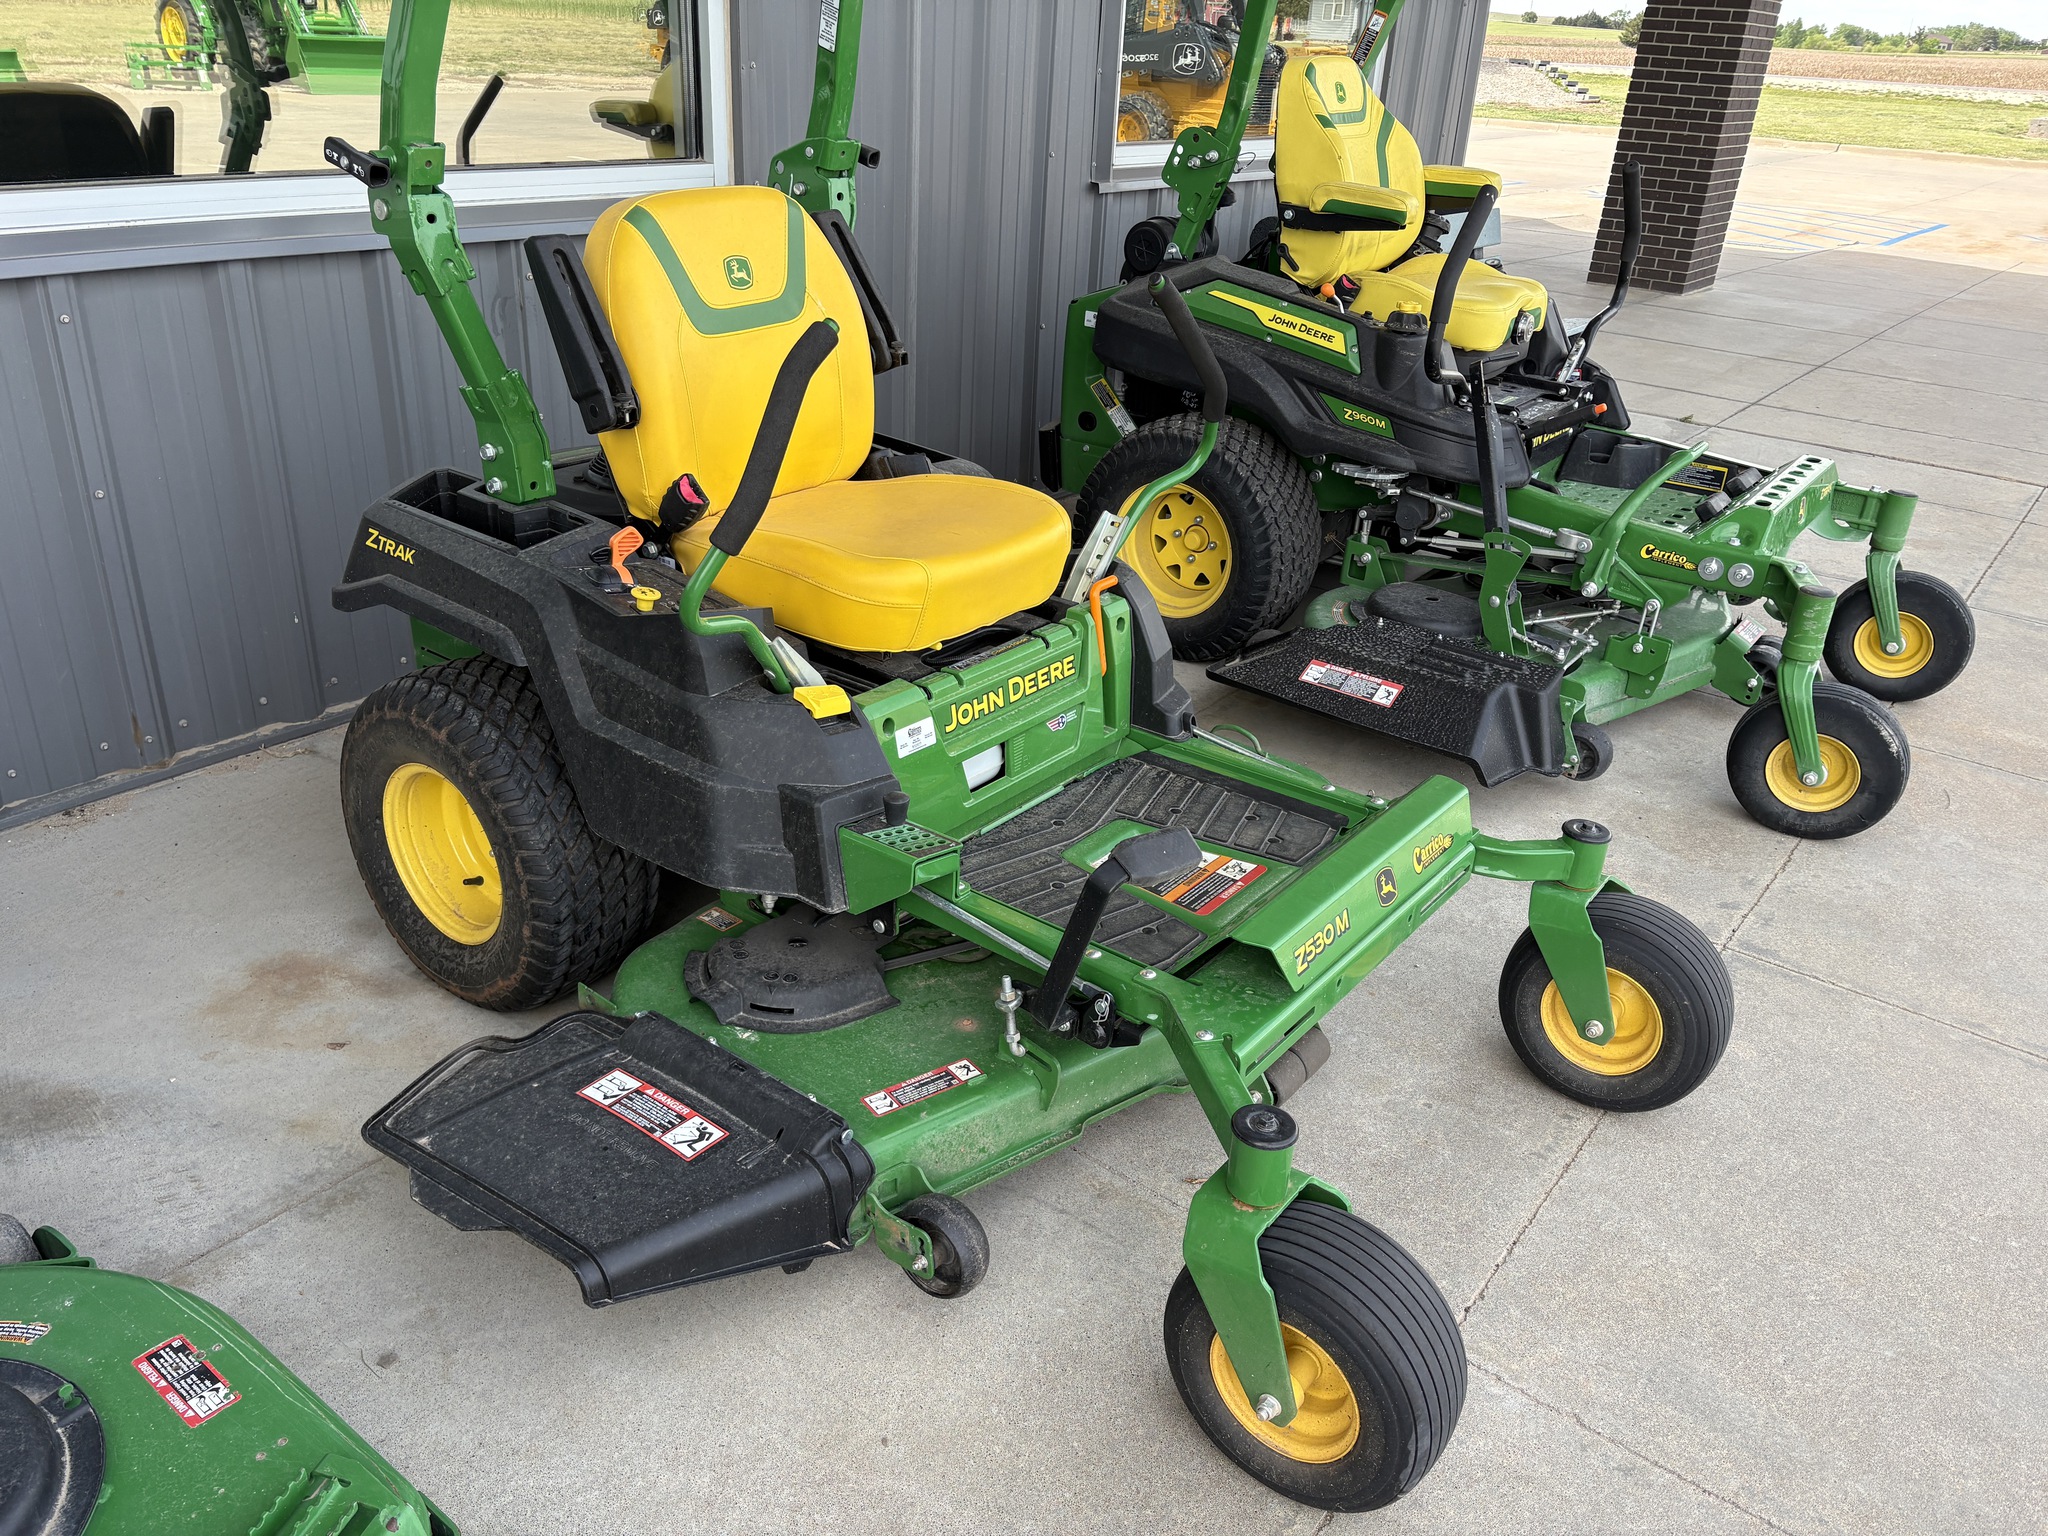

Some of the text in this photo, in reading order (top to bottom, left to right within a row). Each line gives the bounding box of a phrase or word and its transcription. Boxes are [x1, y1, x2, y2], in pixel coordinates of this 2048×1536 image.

[1268, 313, 1336, 344] JOHN DEERE
[365, 527, 416, 565] ZTRAK
[1640, 543, 1687, 564] Carrico
[944, 654, 1076, 734] JOHN DEERE
[1413, 833, 1444, 874] Carrico
[905, 1071, 934, 1085] DANGER
[654, 1092, 691, 1116] DANGER
[571, 1112, 590, 1127] DO
[587, 1122, 614, 1141] NOT
[609, 1136, 661, 1170] REMOVE
[138, 1361, 162, 1384] PELIGRO
[165, 1391, 189, 1413] DANGER
